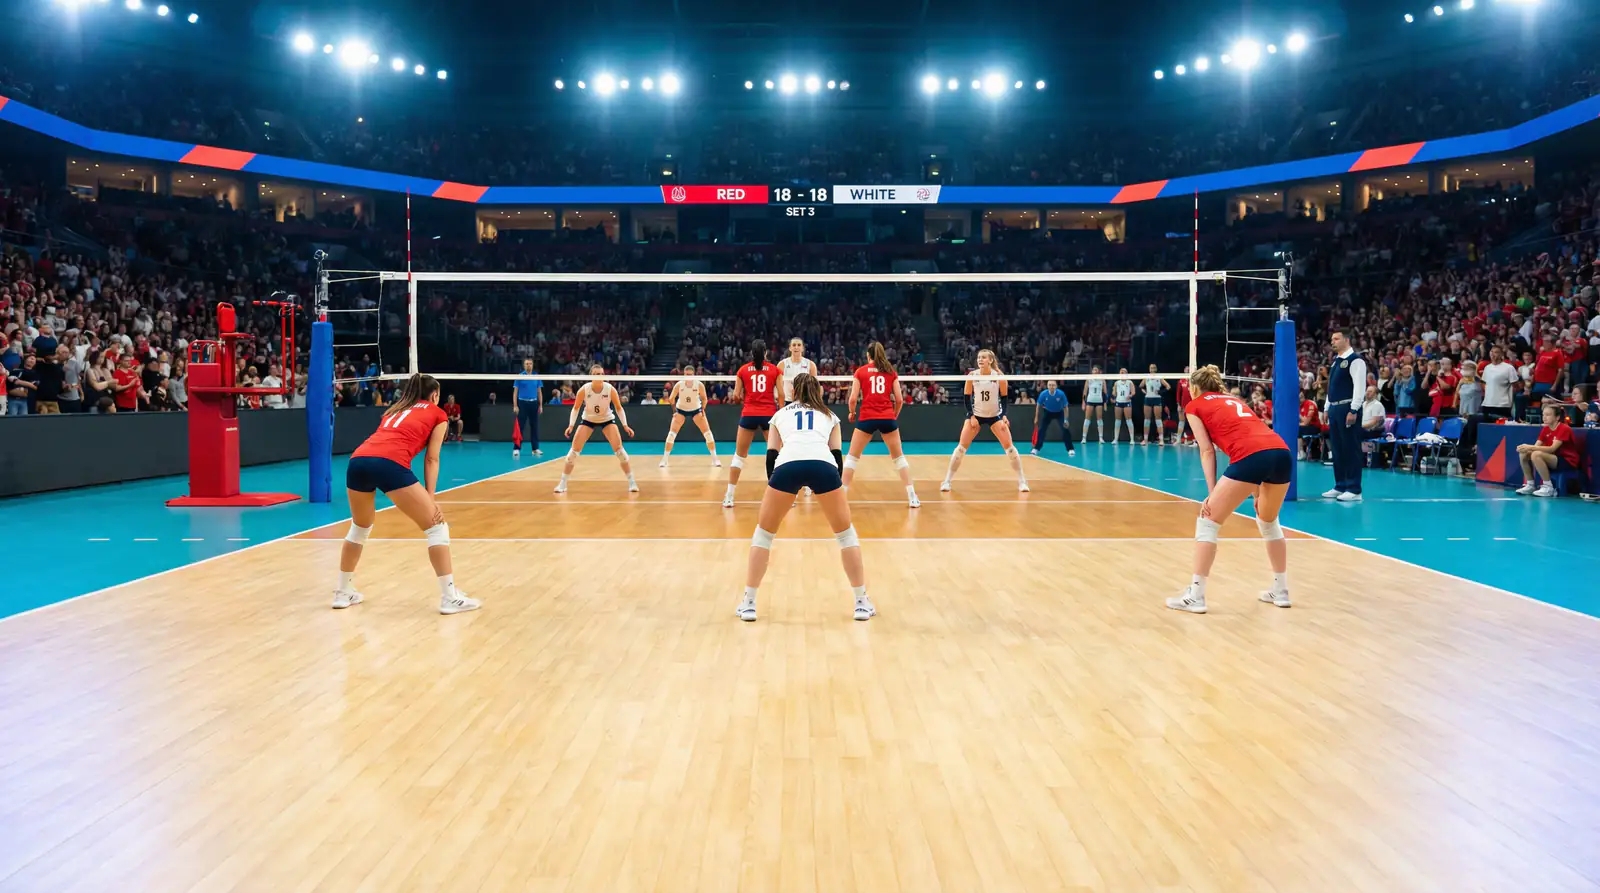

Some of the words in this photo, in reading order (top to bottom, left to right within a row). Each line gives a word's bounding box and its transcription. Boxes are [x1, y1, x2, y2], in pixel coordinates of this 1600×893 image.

[716, 188, 746, 201] RED
[774, 188, 792, 202] 18
[809, 188, 828, 202] 18
[849, 188, 896, 201] WHITE
[785, 206, 806, 217] SET
[807, 206, 815, 217] 3
[750, 374, 767, 393] 18
[869, 375, 886, 394] 18
[594, 405, 601, 414] 6
[1225, 399, 1253, 418] 2
[383, 409, 412, 428] 11
[794, 410, 814, 430] 11
